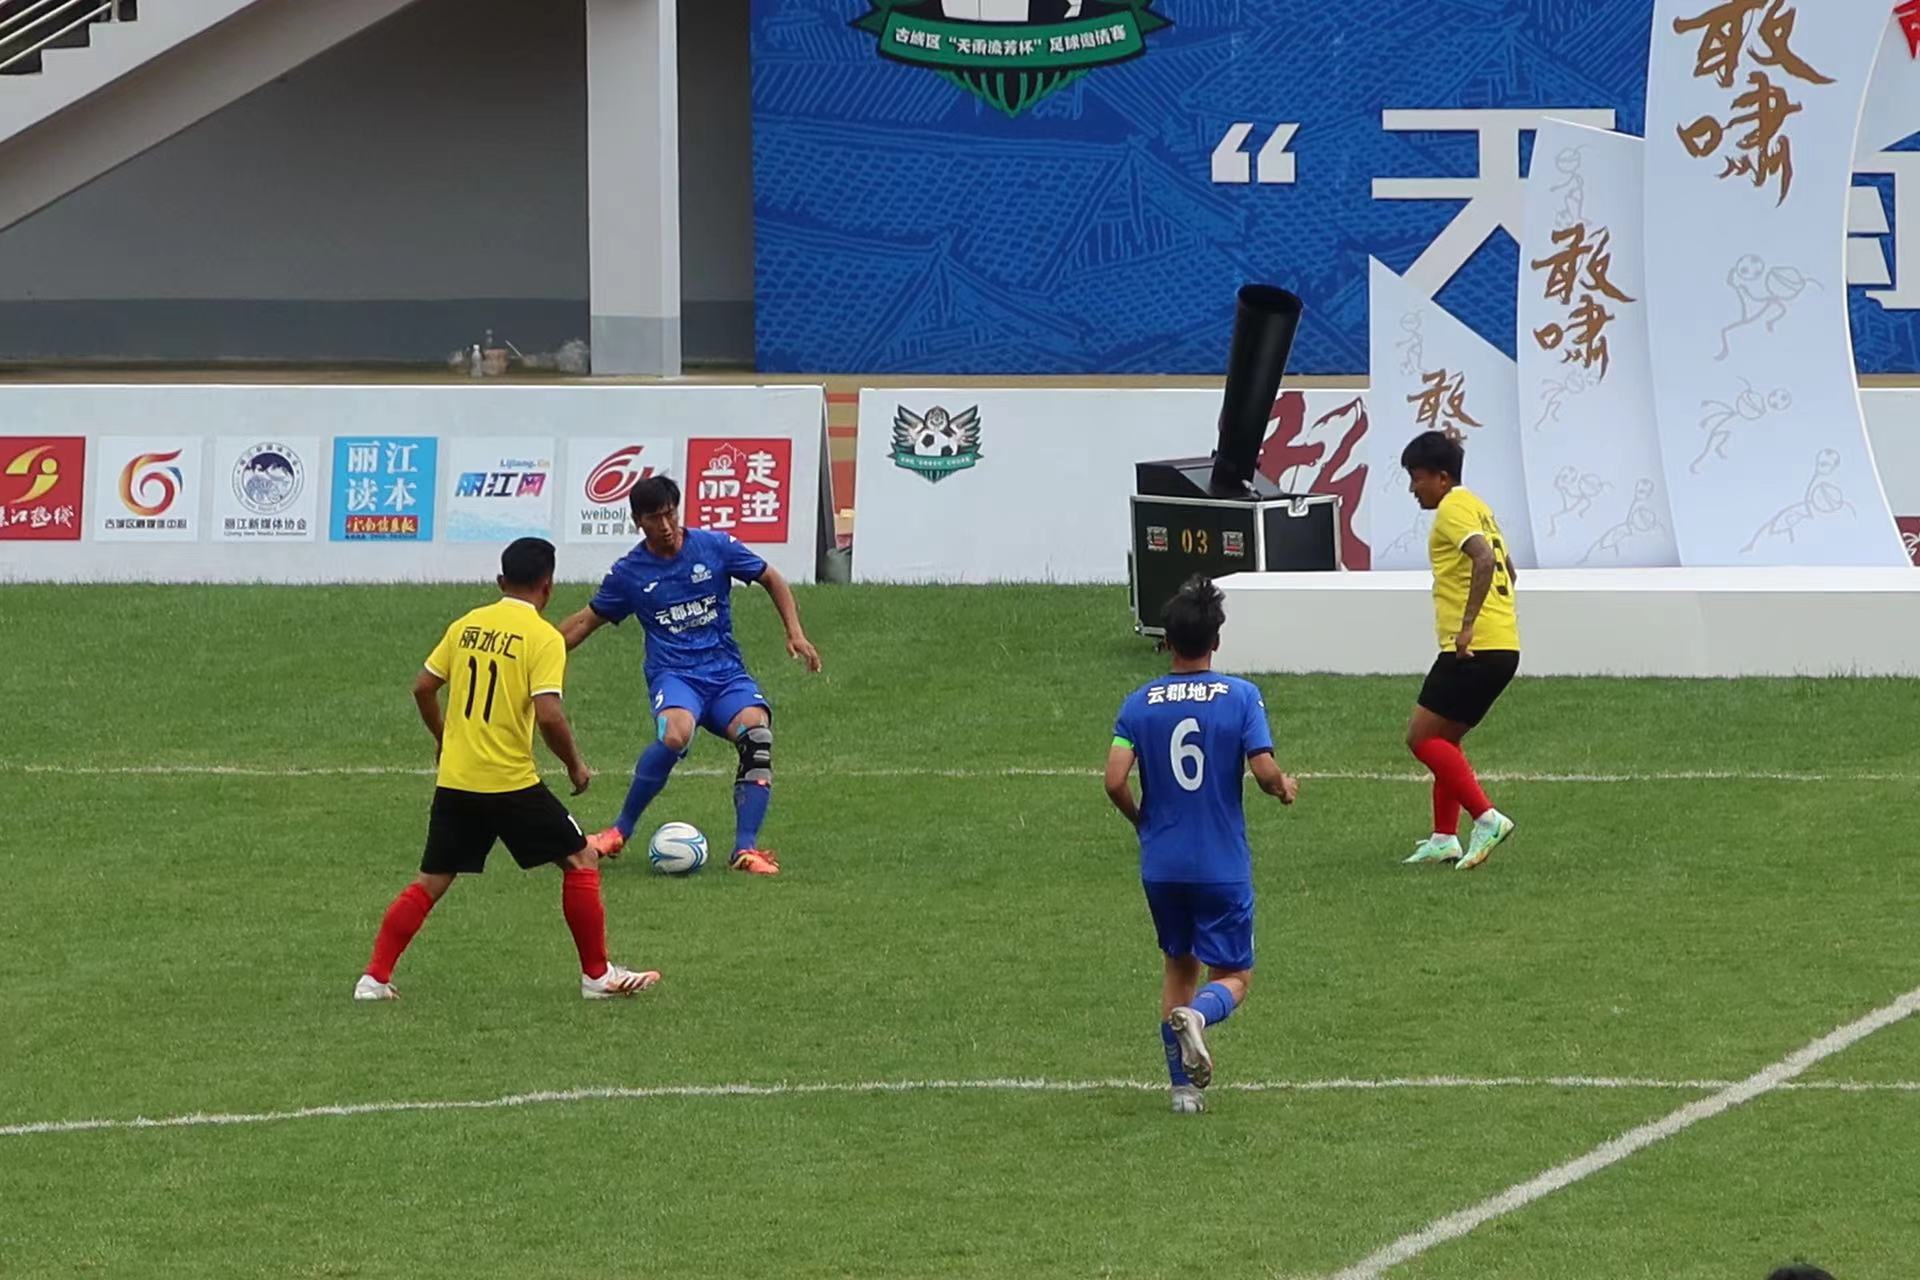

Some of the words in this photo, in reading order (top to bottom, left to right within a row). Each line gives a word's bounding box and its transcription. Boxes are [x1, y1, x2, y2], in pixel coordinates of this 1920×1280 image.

[895, 27, 941, 50] 古城区
[346, 440, 419, 474] 丽江
[345, 478, 417, 512] 读本
[455, 472, 546, 497] 丽江网
[698, 455, 741, 530] 丽江
[741, 450, 780, 523] 走进
[224, 518, 307, 530] 丽江新媒体协会
[1181, 528, 1208, 555] 03
[458, 626, 523, 660] 丽水汇
[464, 655, 498, 724] 11
[1170, 717, 1205, 791] 6
